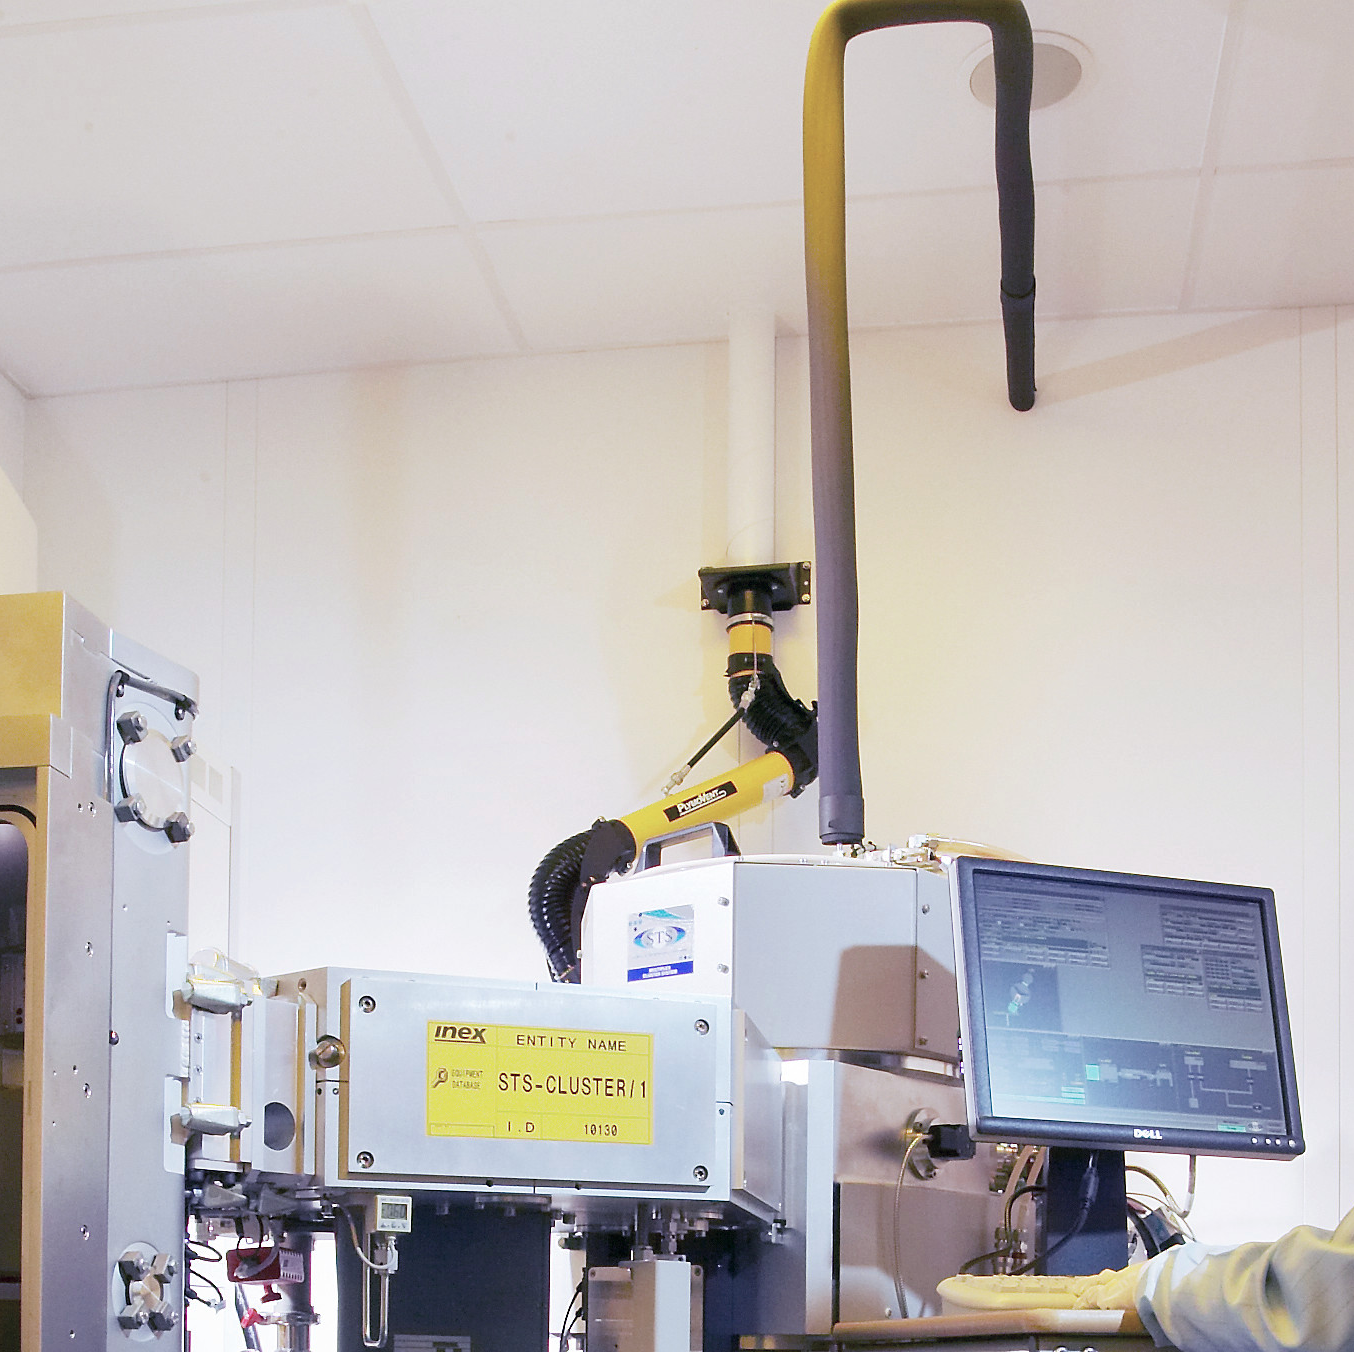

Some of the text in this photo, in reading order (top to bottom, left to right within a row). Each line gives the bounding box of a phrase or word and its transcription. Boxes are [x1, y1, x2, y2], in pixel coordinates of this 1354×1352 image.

[516, 1034, 627, 1052] ENTITY NAME
[498, 1072, 647, 1099] STS-CLUSTER/1
[584, 1124, 618, 1136] 10130
[1133, 1128, 1163, 1140] DELL
